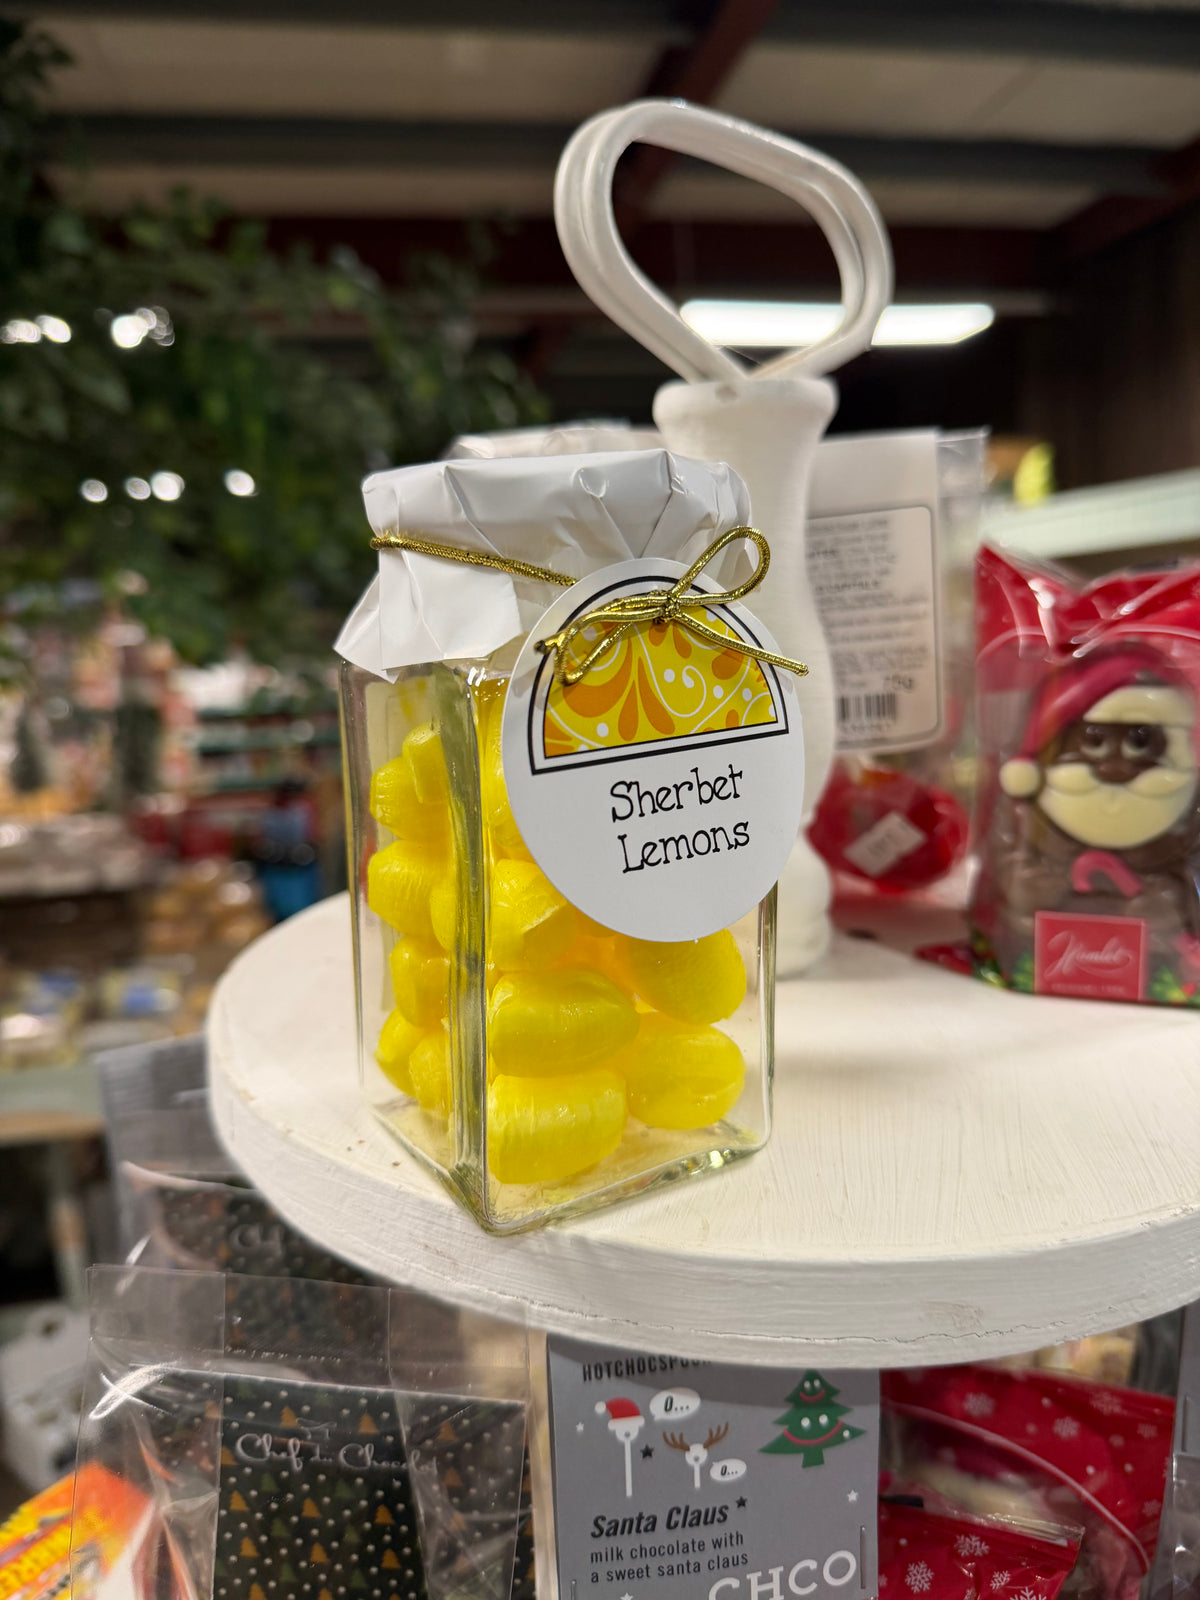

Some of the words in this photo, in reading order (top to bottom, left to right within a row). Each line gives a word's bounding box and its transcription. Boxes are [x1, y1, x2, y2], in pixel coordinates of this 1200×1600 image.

[610, 763, 743, 823] Sherbet
[617, 821, 750, 874] Lemons
[582, 1355, 713, 1382] HOTCHOCSPO
[590, 1511, 658, 1539] Santa
[665, 1504, 729, 1531] Claus
[590, 1546, 624, 1564] milk
[630, 1537, 706, 1560] chocolate
[711, 1530, 744, 1550] with
[591, 1571, 599, 1584] a
[606, 1564, 651, 1582] sweet
[657, 1559, 701, 1577] santa
[707, 1552, 749, 1571] claus
